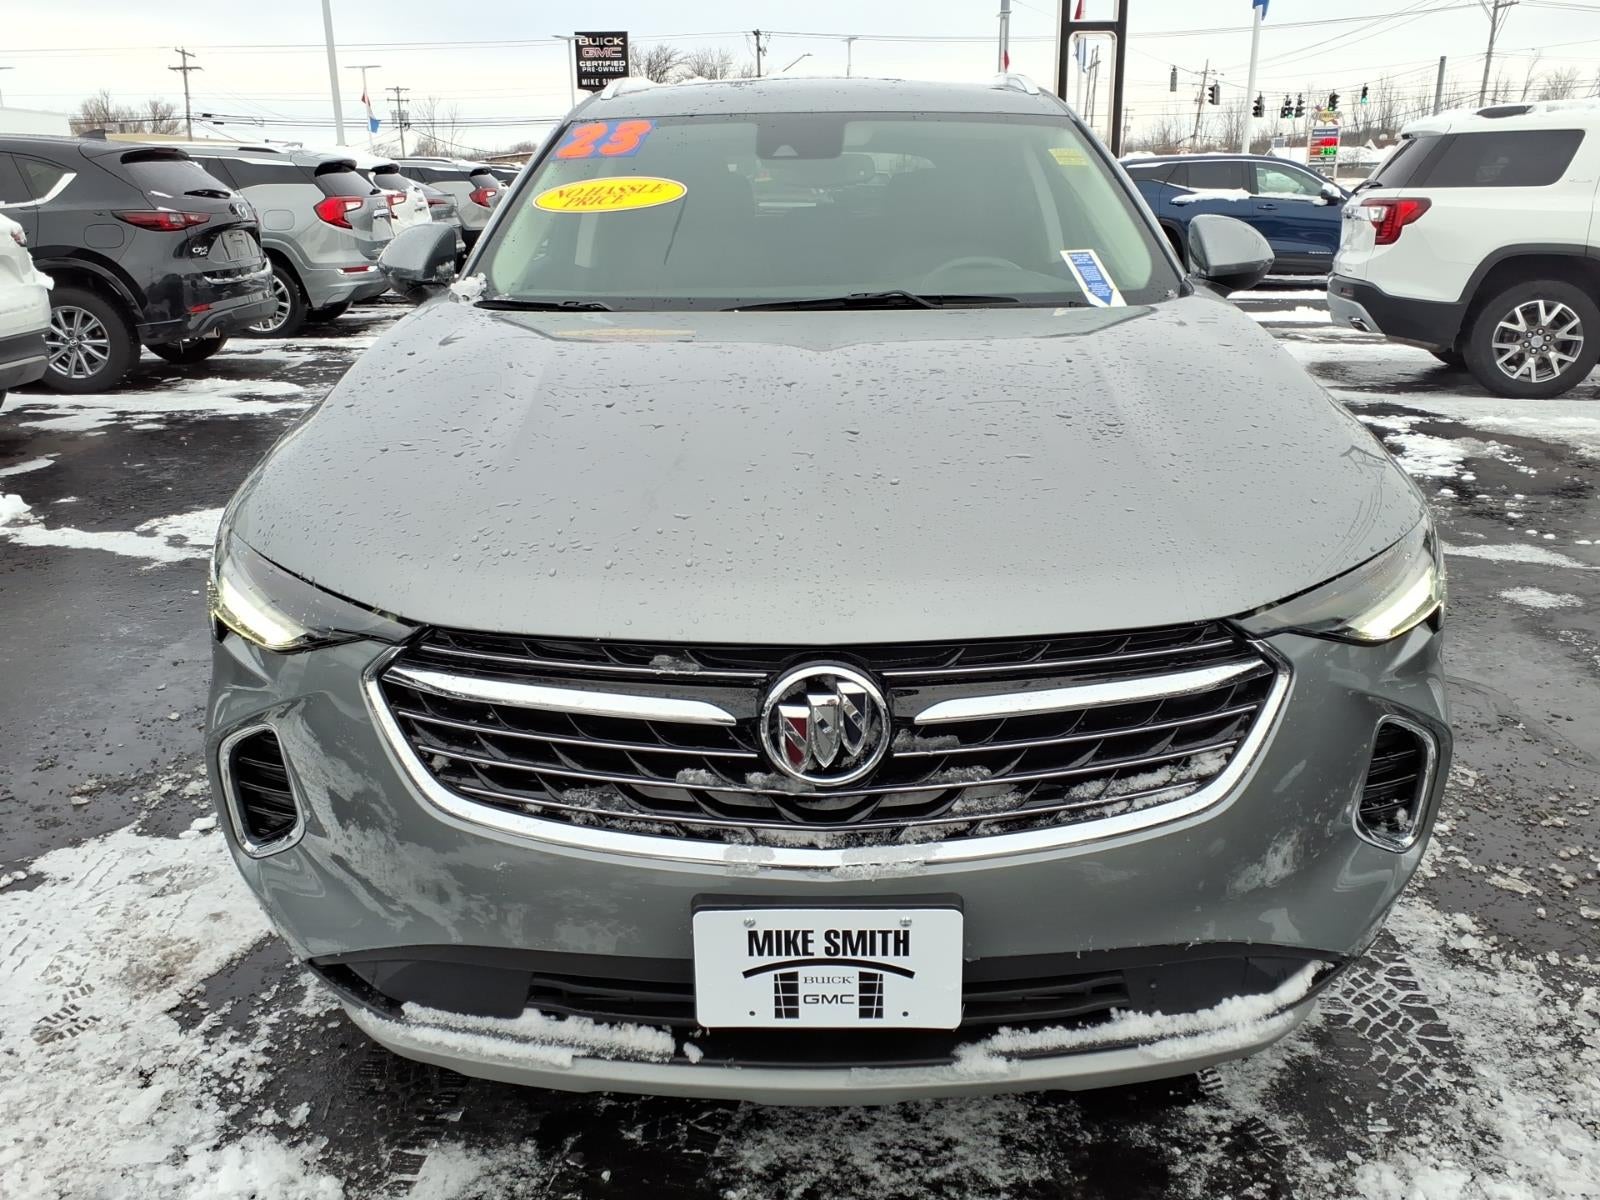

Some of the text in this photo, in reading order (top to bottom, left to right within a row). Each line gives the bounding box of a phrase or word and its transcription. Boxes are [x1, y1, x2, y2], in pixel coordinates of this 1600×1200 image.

[578, 37, 624, 46] BUICK
[582, 47, 622, 58] GMC
[555, 120, 653, 159] 23
[552, 184, 663, 200] NO HASSLE
[563, 195, 625, 207] PRICE
[748, 929, 910, 957] MIKE SMITH
[803, 975, 853, 984] BUICK
[803, 994, 855, 1005] GMC
